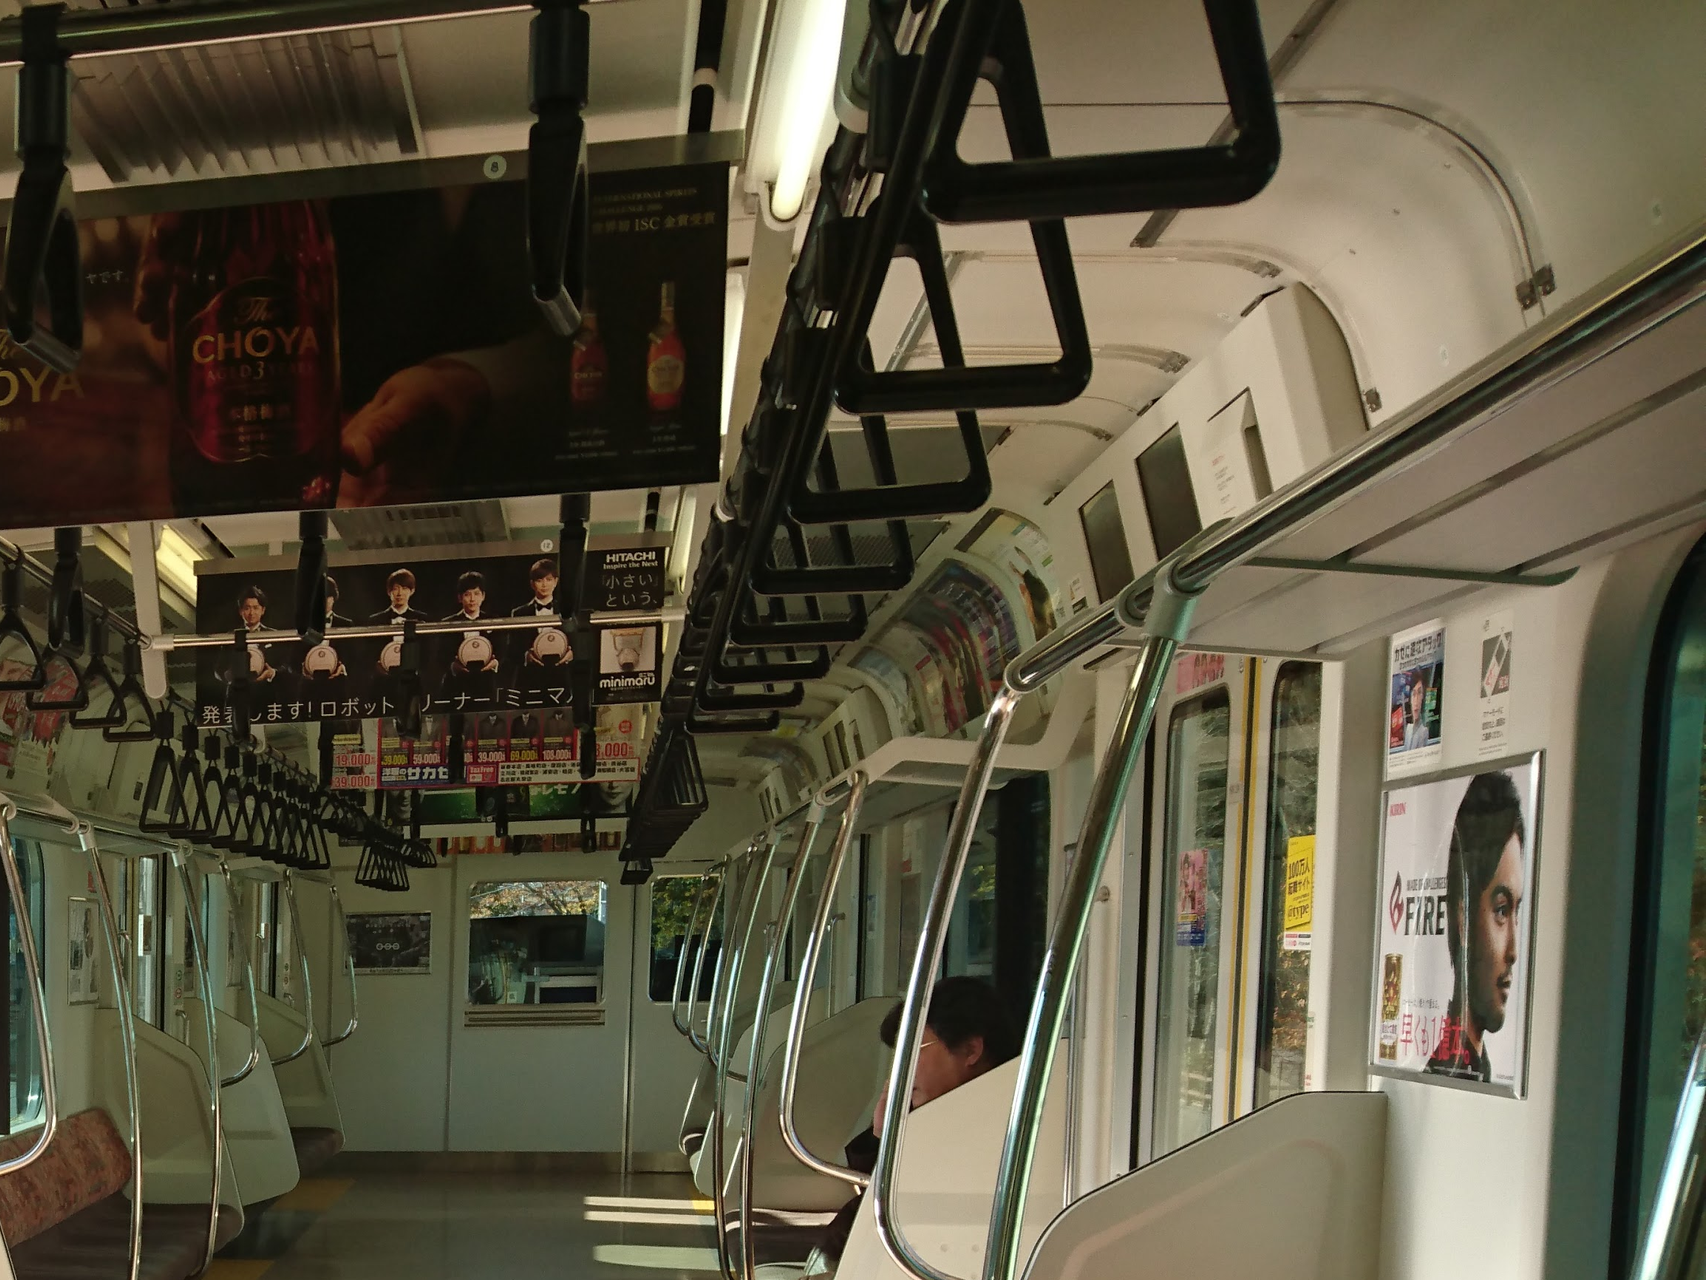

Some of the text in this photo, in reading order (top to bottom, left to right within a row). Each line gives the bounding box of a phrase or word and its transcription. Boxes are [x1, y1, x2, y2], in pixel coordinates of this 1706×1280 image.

[634, 217, 661, 231] ISC
[192, 326, 320, 364] CHOYA
[253, 360, 266, 380] 3
[603, 560, 659, 571] Inspire the Next
[605, 551, 656, 563] HITACHI
[602, 573, 659, 590] 「小さい」
[605, 591, 658, 608] という、
[599, 675, 655, 689] minimaru
[1389, 802, 1407, 817] KIRIN
[1288, 857, 1311, 880] 100万人
[1287, 903, 1310, 922] @type
[1403, 894, 1447, 936] FIRE
[1399, 1012, 1471, 1066] 早くも1億本。
